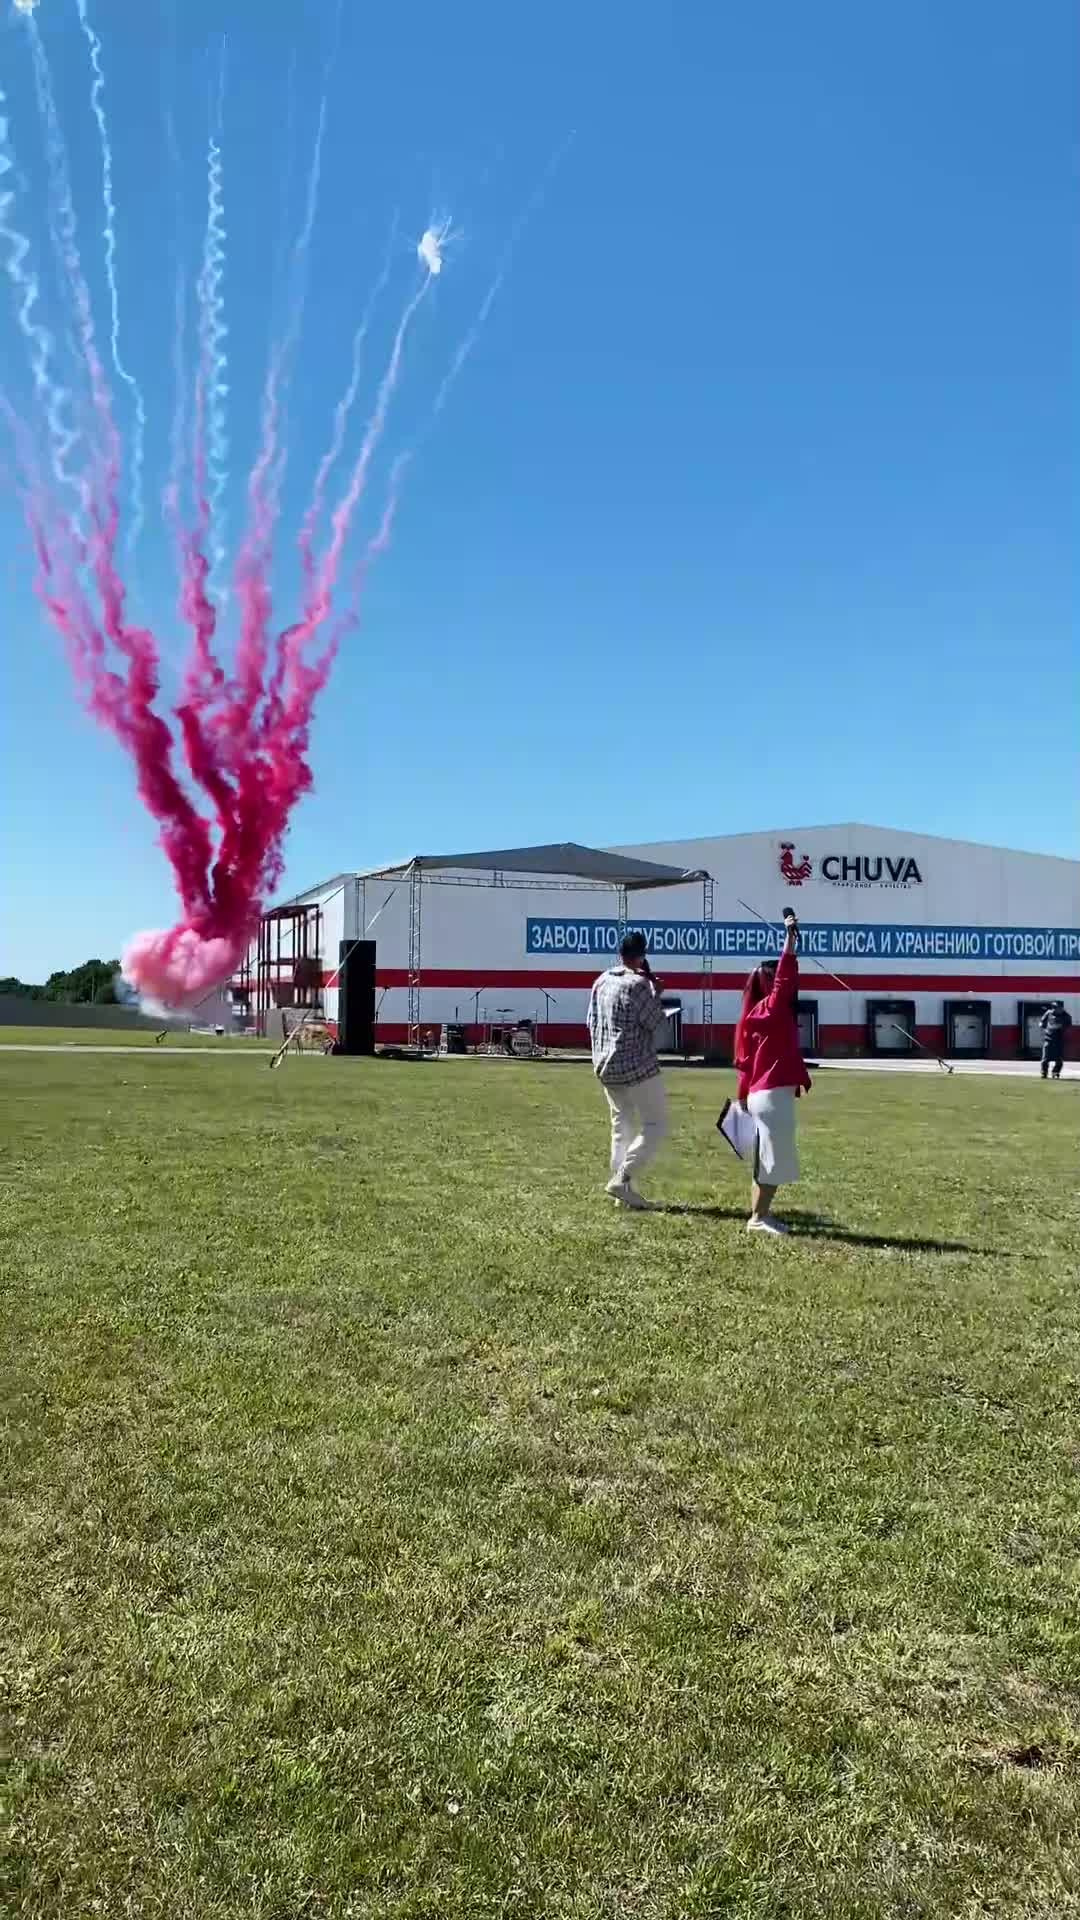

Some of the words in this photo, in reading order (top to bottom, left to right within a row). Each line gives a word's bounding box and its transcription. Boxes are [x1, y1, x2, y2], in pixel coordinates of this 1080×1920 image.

[822, 856, 922, 882] CHUVA
[532, 925, 590, 952] ЗАВОД
[595, 926, 618, 950] ПО
[714, 929, 828, 952] ПЕРЕРАБТКЕ
[832, 931, 876, 953] МЯСА
[880, 932, 892, 953] И
[895, 931, 980, 954] ХРАНЕНИЮ
[985, 930, 1055, 956] ГОТОВОЙ
[1059, 934, 1080, 957] ПР
